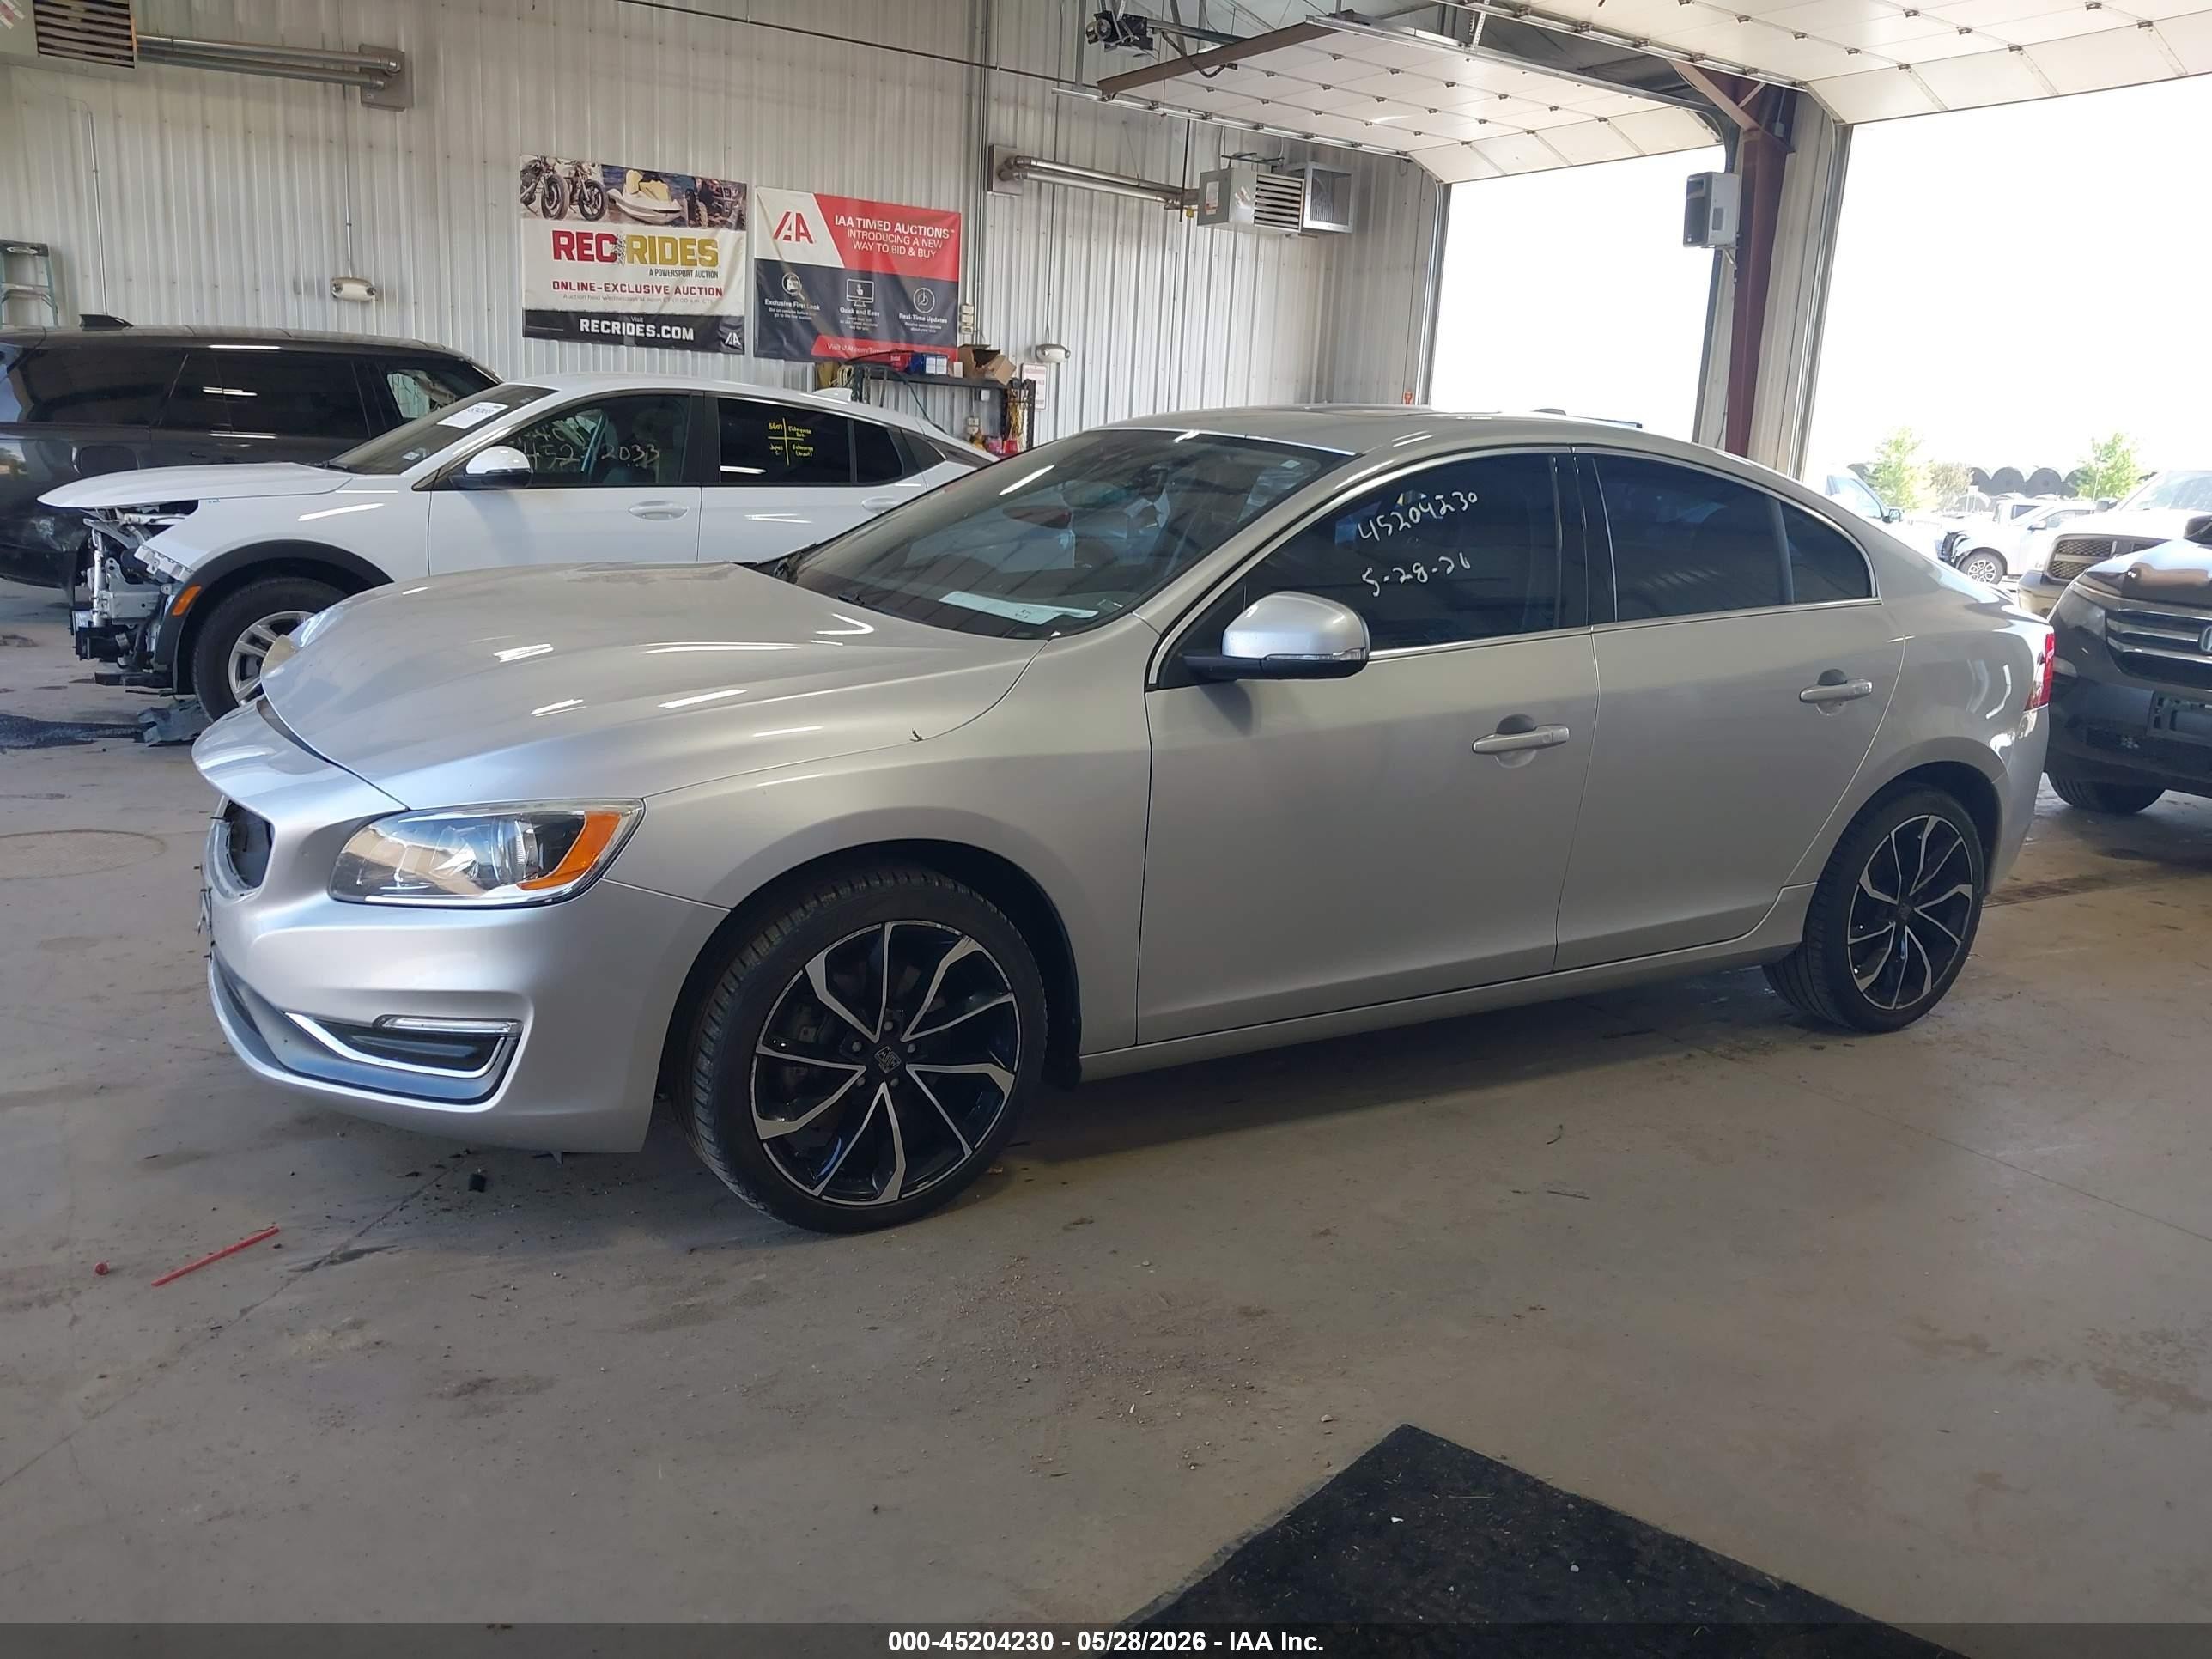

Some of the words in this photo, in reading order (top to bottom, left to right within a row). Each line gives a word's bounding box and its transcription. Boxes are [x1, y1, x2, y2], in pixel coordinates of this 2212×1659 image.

[834, 214, 854, 228] IAA
[856, 216, 891, 232] TIMED
[847, 228, 911, 246] INTRODUCING
[912, 236, 921, 246] A
[921, 238, 943, 249] NEW
[551, 229, 618, 263] REC
[626, 234, 720, 268] RIDES
[853, 240, 874, 251] WAY
[876, 242, 890, 252] TO
[891, 245, 907, 255] BID
[908, 246, 916, 257] &
[917, 247, 937, 258] BUY
[654, 269, 694, 278] POWERSPORT
[694, 270, 719, 279] AUCTION
[552, 280, 670, 295] ONLINE-EXCLUSIVE
[674, 285, 723, 296] AUCTION
[764, 298, 793, 307] Exclusive
[866, 309, 880, 318] Easy
[899, 313, 926, 322] Real-Time
[927, 315, 947, 324] Updates
[580, 319, 695, 341] RECRIDES.COM
[1358, 491, 1478, 542] 45204230
